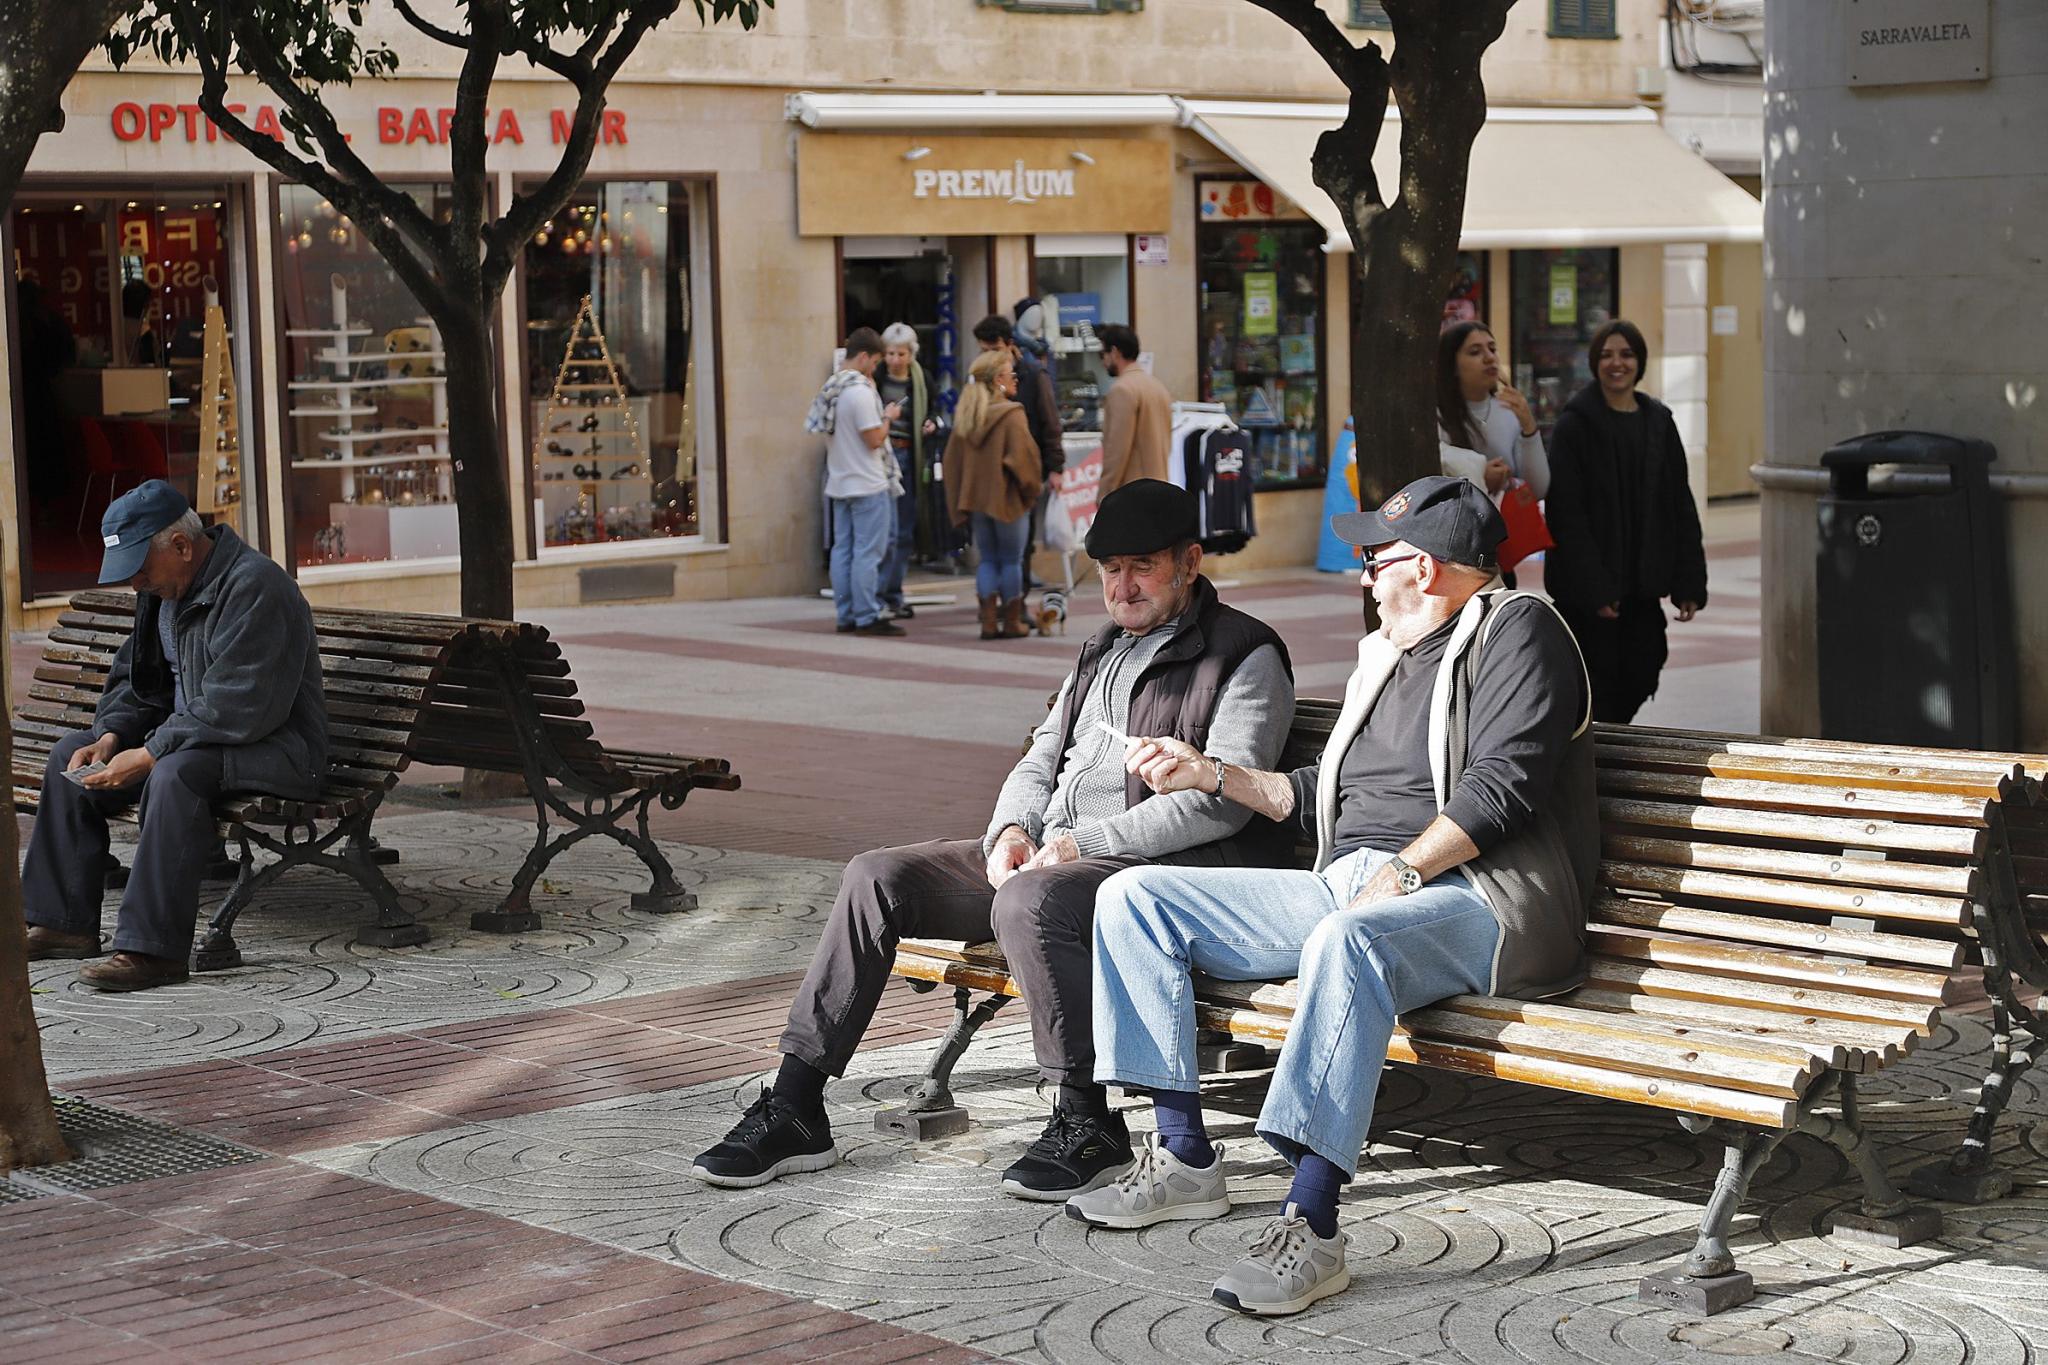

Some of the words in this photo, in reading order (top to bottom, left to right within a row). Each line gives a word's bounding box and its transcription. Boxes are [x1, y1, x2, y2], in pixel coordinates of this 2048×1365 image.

[1860, 23, 1972, 46] SARRAVALETA
[378, 107, 524, 145] BARA
[550, 109, 628, 145] MR
[913, 159, 1075, 204] PREMIUM
